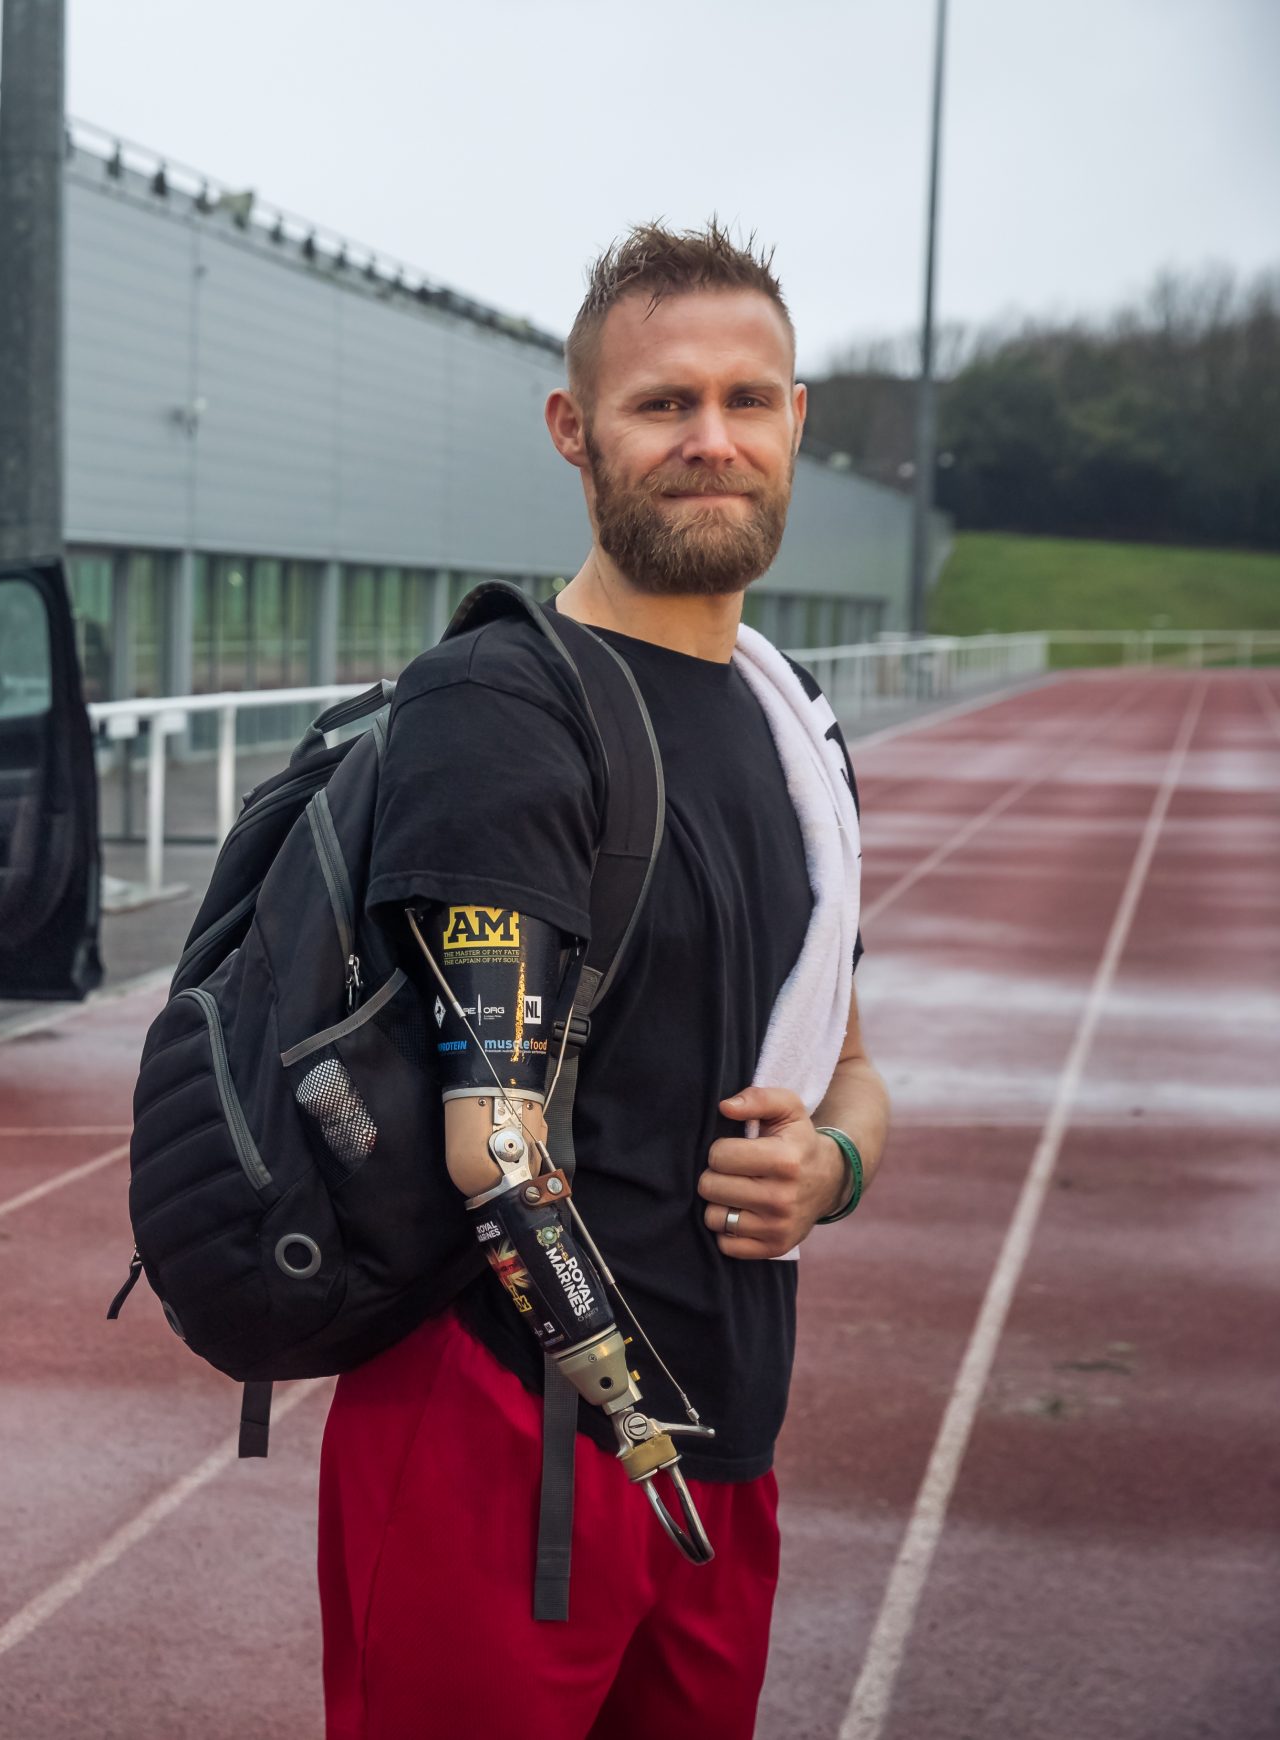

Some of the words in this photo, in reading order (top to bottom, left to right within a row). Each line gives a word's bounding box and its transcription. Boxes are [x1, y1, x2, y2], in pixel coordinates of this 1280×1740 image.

[525, 1000, 540, 1019] NL
[545, 1246, 587, 1317] MARINES
[565, 1256, 595, 1311] ROYAL
